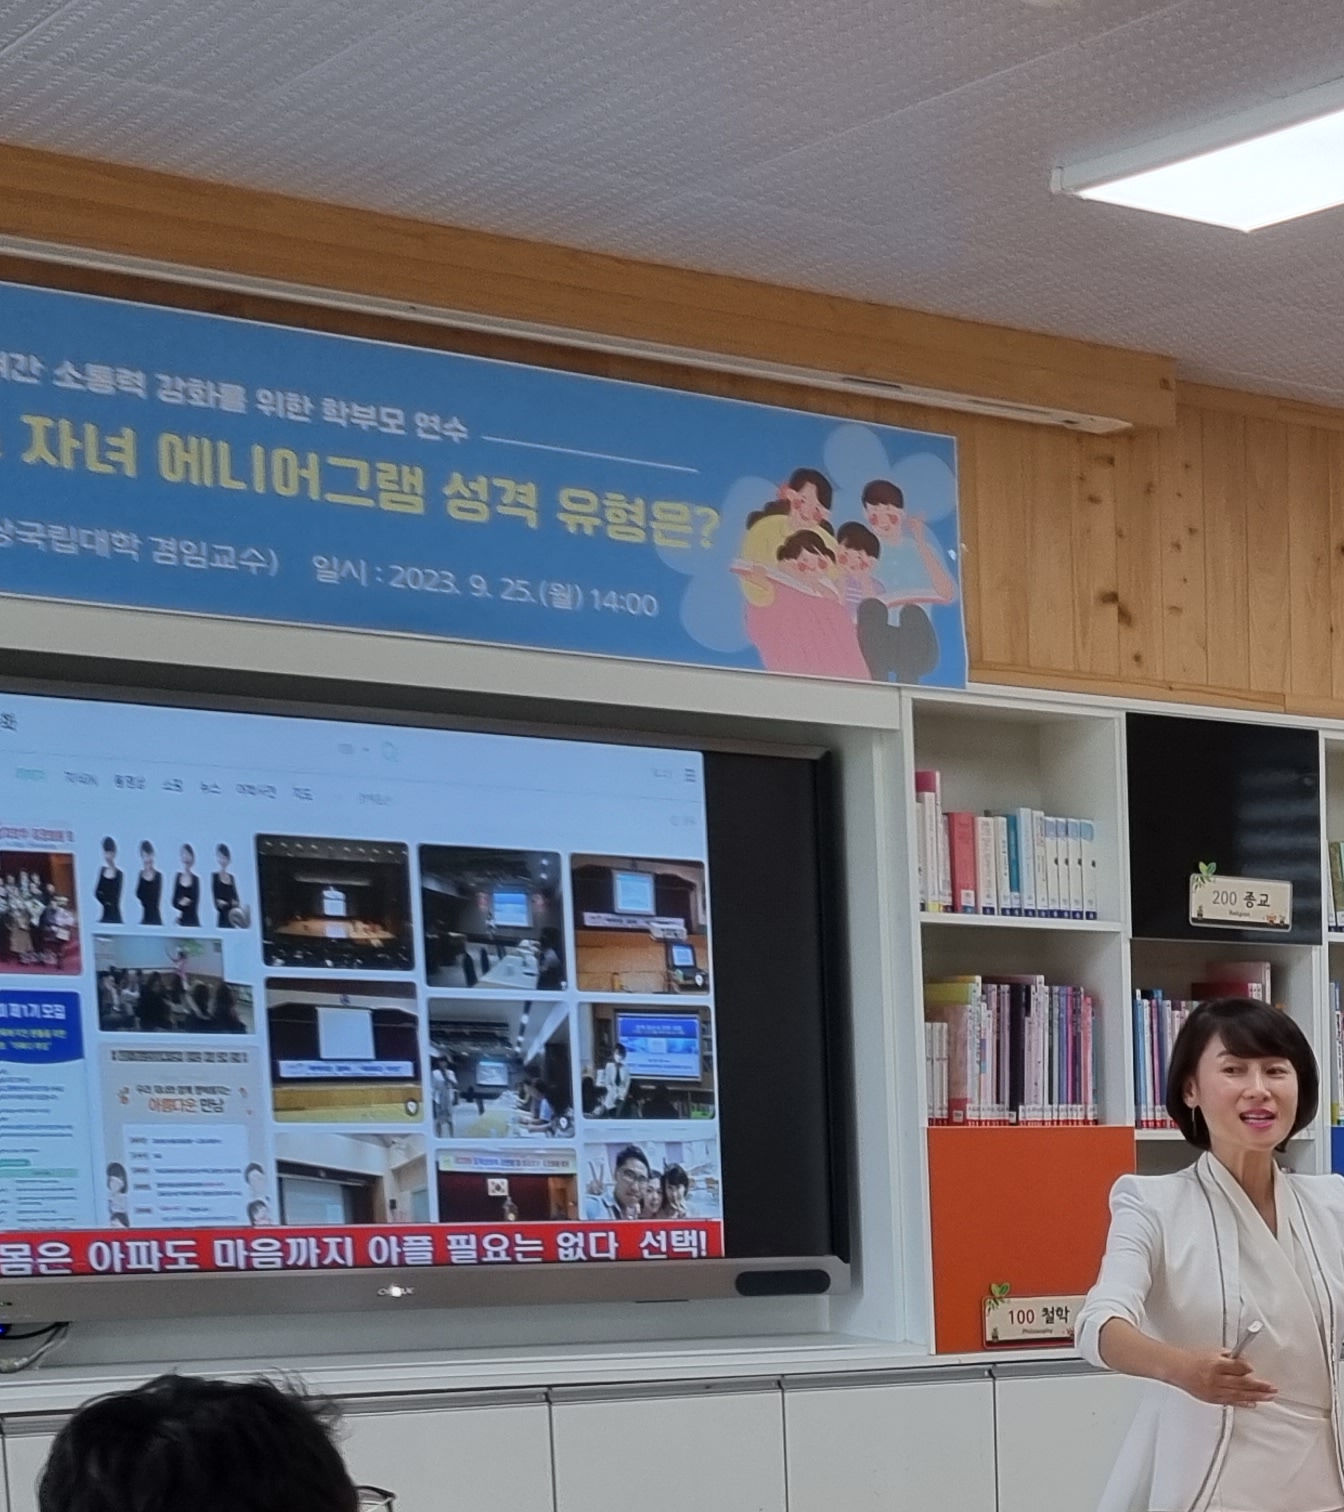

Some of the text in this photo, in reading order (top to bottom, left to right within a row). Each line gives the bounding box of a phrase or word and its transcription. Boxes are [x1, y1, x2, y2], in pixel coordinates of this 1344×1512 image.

[0, 352, 469, 444] 간 소통력 강화를 위한 학부모 연수
[20, 413, 720, 549] 자녀 에니어그램 성격 유형은?
[148, 535, 279, 577] 겸임교수)
[312, 555, 368, 587] 일시
[388, 564, 462, 596] 2023.
[469, 574, 494, 599] 9.
[500, 577, 584, 612] 25.(월)
[591, 588, 660, 617] 14:00
[1212, 890, 1271, 909] 200 종교
[0, 1229, 708, 1276] 몸은 아파도 마음까지 아플 필요는 없다 선택!
[1009, 1305, 1070, 1325] 100 철학
